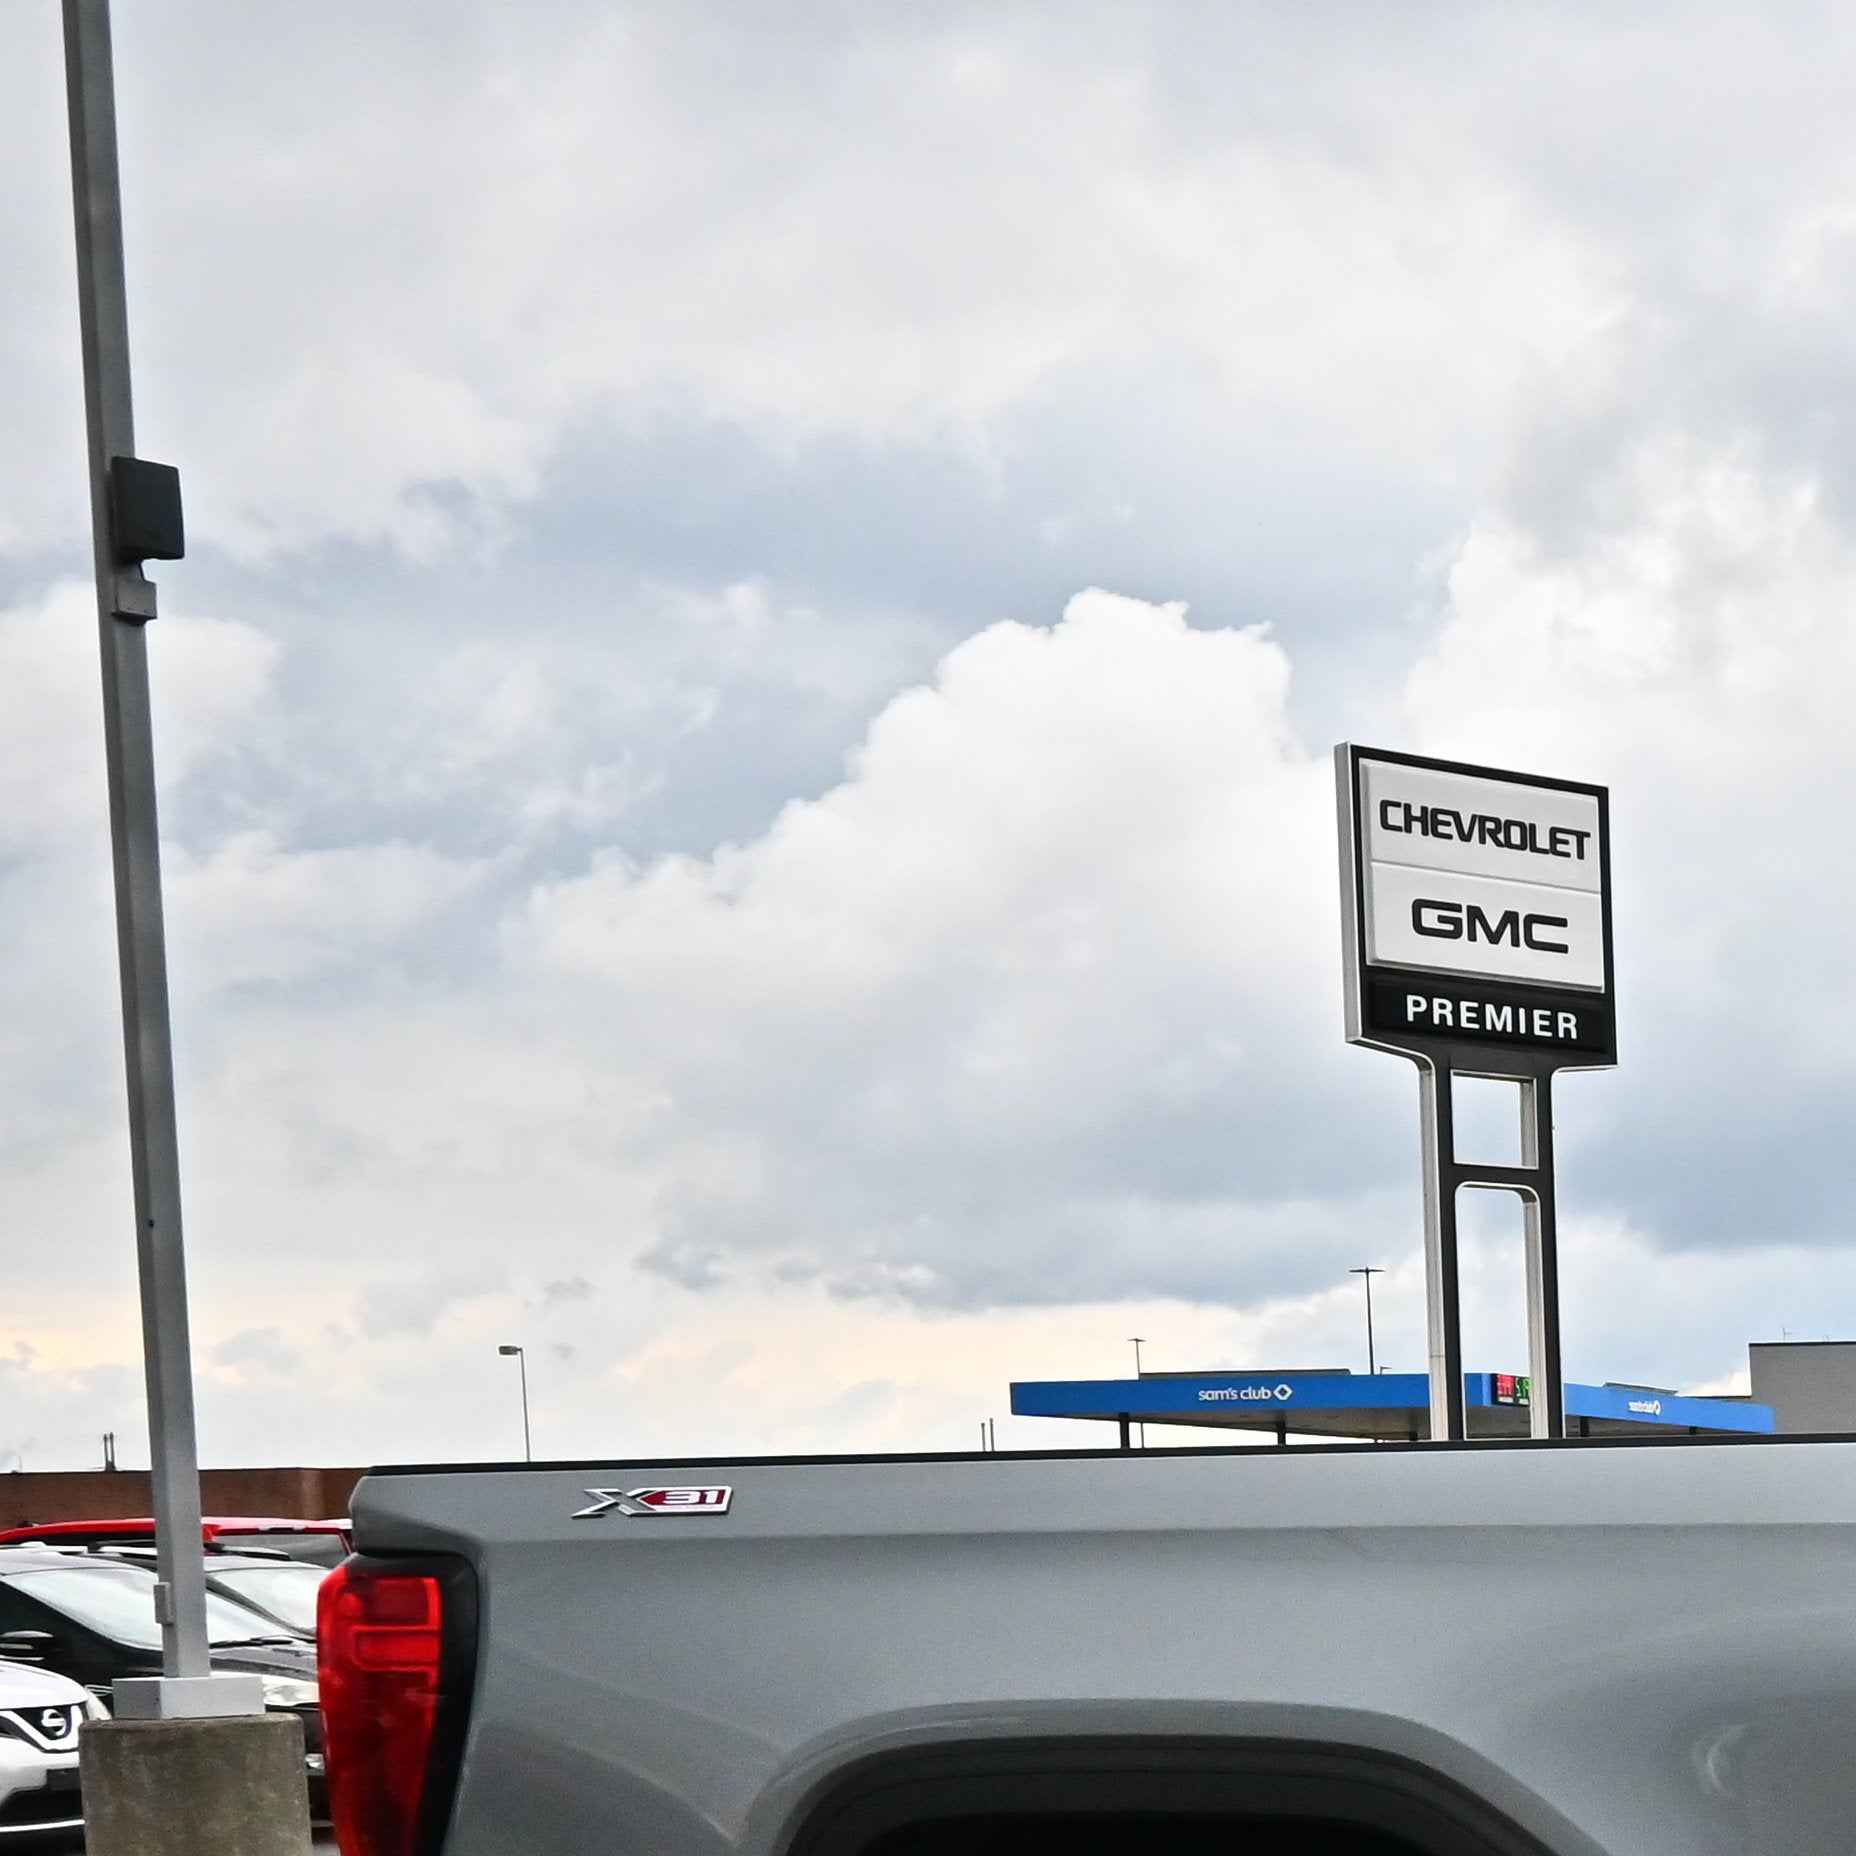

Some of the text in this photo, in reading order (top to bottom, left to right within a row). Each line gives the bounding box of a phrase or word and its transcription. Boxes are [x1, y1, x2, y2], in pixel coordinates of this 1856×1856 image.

[1379, 799, 1591, 860] CHEVROLET
[1411, 898, 1569, 954] GMC
[1406, 994, 1578, 1040] PREMIER
[1198, 1386, 1272, 1401] sam's club
